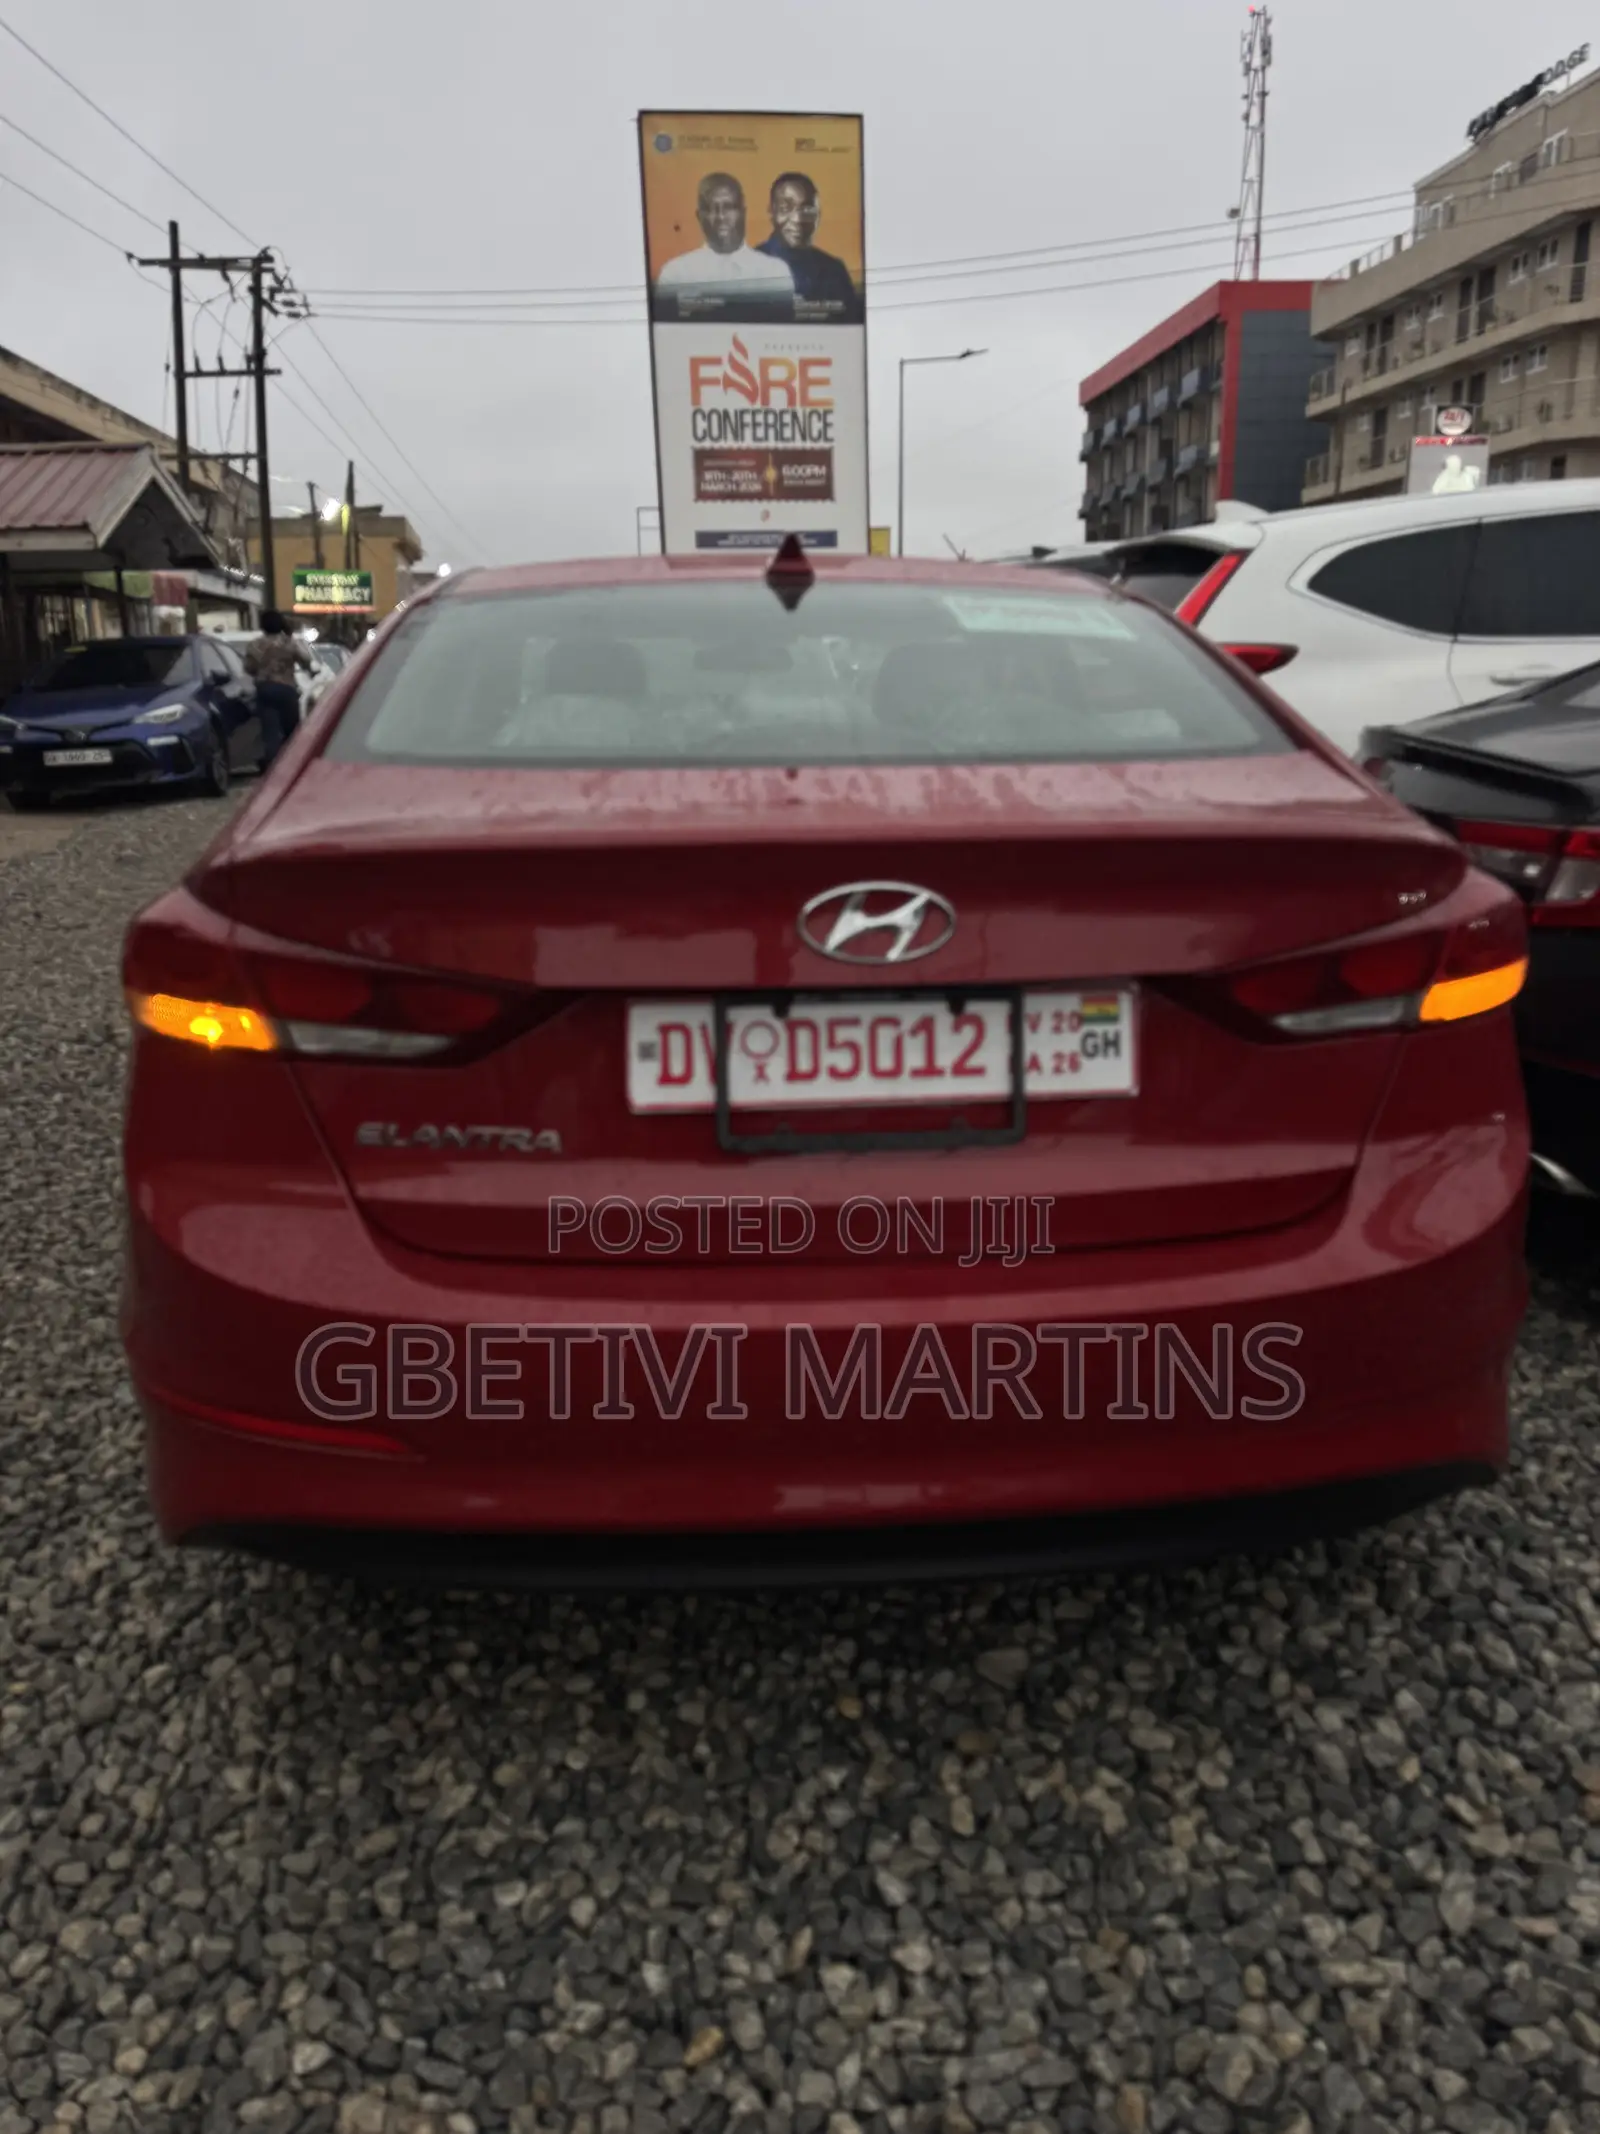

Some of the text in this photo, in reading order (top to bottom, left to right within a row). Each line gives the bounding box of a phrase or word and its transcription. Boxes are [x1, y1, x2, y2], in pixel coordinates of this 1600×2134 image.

[691, 408, 835, 443] CONFERENCE
[784, 1014, 987, 1082] D5012
[1080, 1029, 1122, 1060] GH
[355, 1121, 563, 1154] ELANTRA
